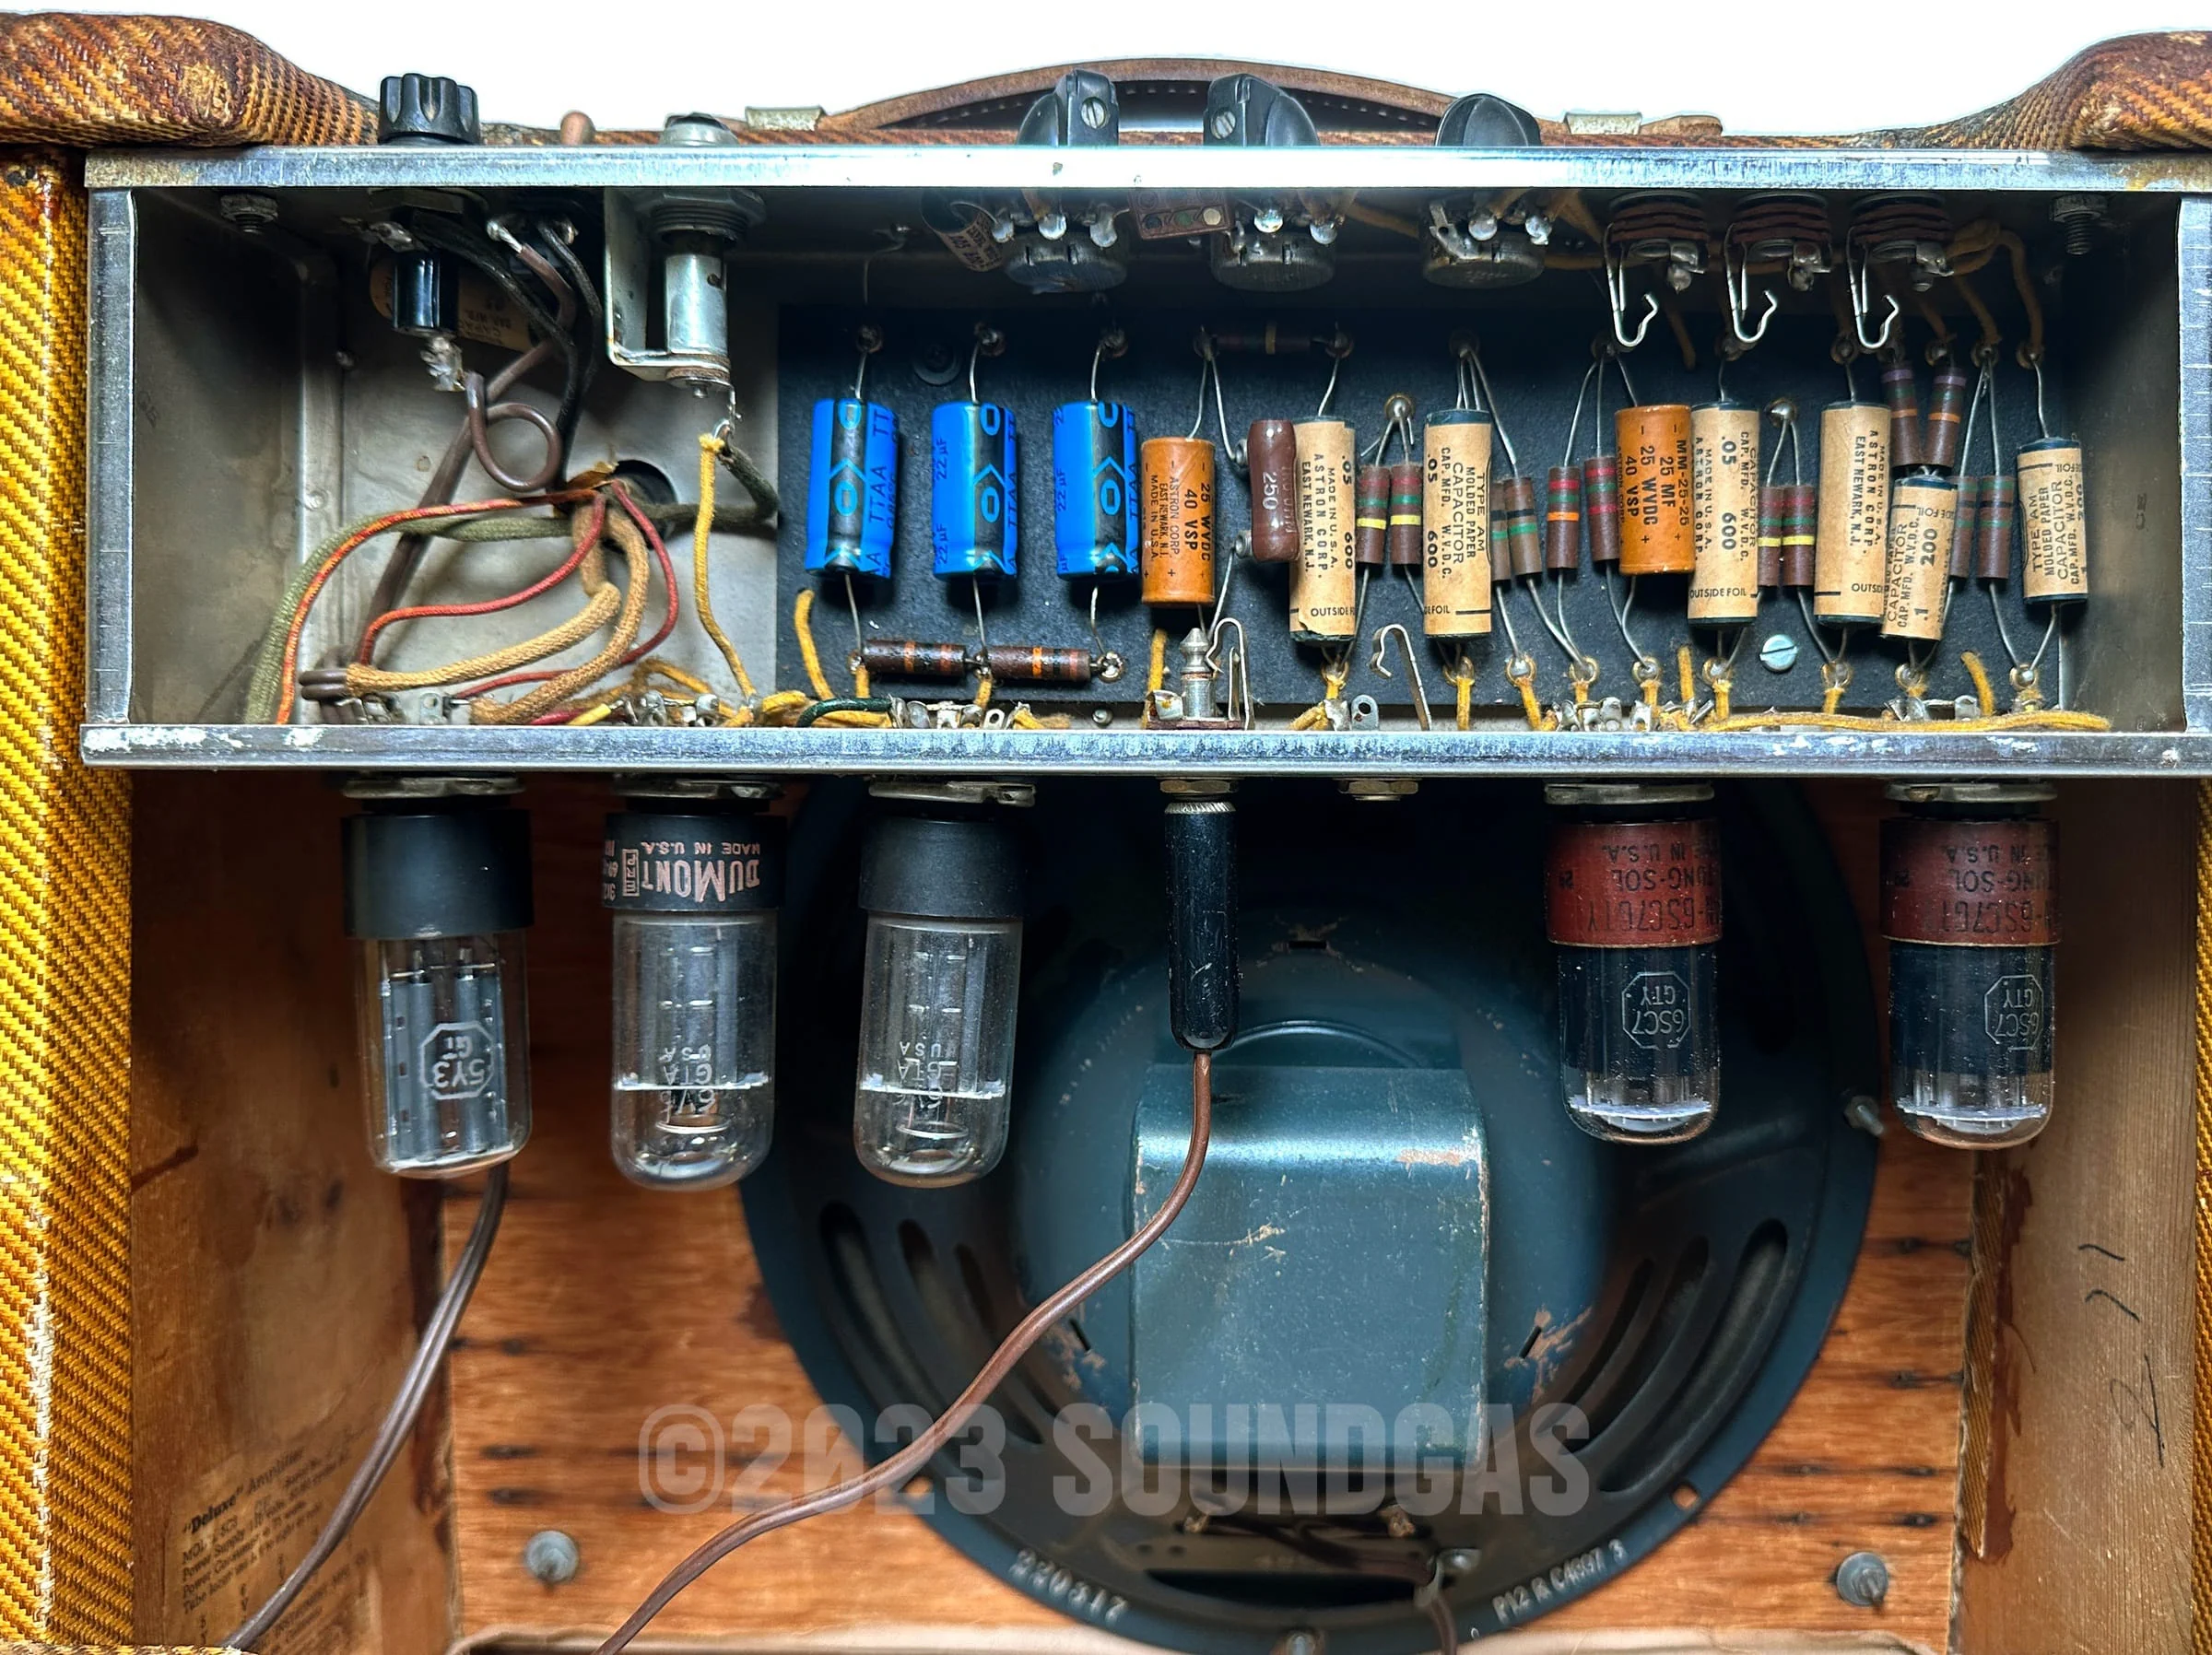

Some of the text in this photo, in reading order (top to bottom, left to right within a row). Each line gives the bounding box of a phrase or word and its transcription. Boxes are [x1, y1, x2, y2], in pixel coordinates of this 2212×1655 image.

[1704, 448, 1712, 486] MADE
[1853, 436, 1866, 464] EAST
[1877, 445, 1886, 482] MADE
[1150, 475, 1159, 507] MADE
[1159, 482, 1169, 502] EAST
[1169, 475, 1181, 520] ASTRON
[1262, 470, 1279, 511] 250
[1301, 462, 1312, 493] EAST
[1327, 467, 1336, 503] MADE
[1625, 456, 1640, 517] 40 VSP
[1641, 445, 1659, 526] 25 WVDC
[1660, 456, 1676, 508] 25 MF
[1676, 440, 1690, 526] MM-25-25
[1695, 437, 1704, 561] ASTRON CORP.
[1704, 488, 1712, 501] IN
[1721, 436, 1737, 550] .05 600
[1740, 431, 1750, 562] CAP. MFD. W.V.D.C.
[1748, 447, 1757, 548] CAPACITOR
[1850, 468, 1865, 520] NEWARK,
[1863, 429, 1879, 554] ASTRON CORP.
[1877, 485, 1884, 498] IN
[1150, 511, 1159, 522] IN
[1184, 488, 1198, 551] 40 VSP
[1201, 482, 1211, 562] 25 WVDC
[1302, 496, 1314, 546] NEWARK,
[1313, 453, 1328, 579] ASTRON CORP.
[1329, 506, 1337, 520] IN
[1341, 455, 1354, 569] .05 600
[1427, 453, 1440, 569] .05 600
[1441, 447, 1453, 580] CAP. MFD. W.V.D.C.
[1453, 462, 1465, 564] CAPACITOR
[1465, 466, 1477, 558] MOLDED PAPER
[1476, 473, 1486, 551] TYPE AM
[1916, 506, 1939, 518] FOIL
[2028, 495, 2042, 572] TYPE AM
[2038, 487, 2055, 576] MOLDED PAPER
[2051, 481, 2069, 580] CAPACITOR
[2064, 475, 2080, 584] CAP. MFD. W.V.D.C.
[1688, 586, 1747, 600] OUTSIDE FOIL
[1888, 523, 1907, 622] CAPACITOR
[1897, 517, 1920, 628] CAP. MFD. W.V.D.C.
[1913, 528, 1937, 621] .1 200
[1310, 606, 1349, 617] OUTSIDE
[1431, 605, 1452, 616] FOIL
[693, 840, 712, 855] IN
[721, 841, 760, 856] MADE
[1640, 985, 1677, 1006] GTY
[2003, 989, 2033, 1007] GTY
[1631, 1009, 1685, 1035] 6SC7
[1994, 1012, 2039, 1037] 6SC7
[431, 1058, 486, 1088] 5Y3
[663, 1062, 712, 1086] GTA
[898, 1041, 942, 1059] USA
